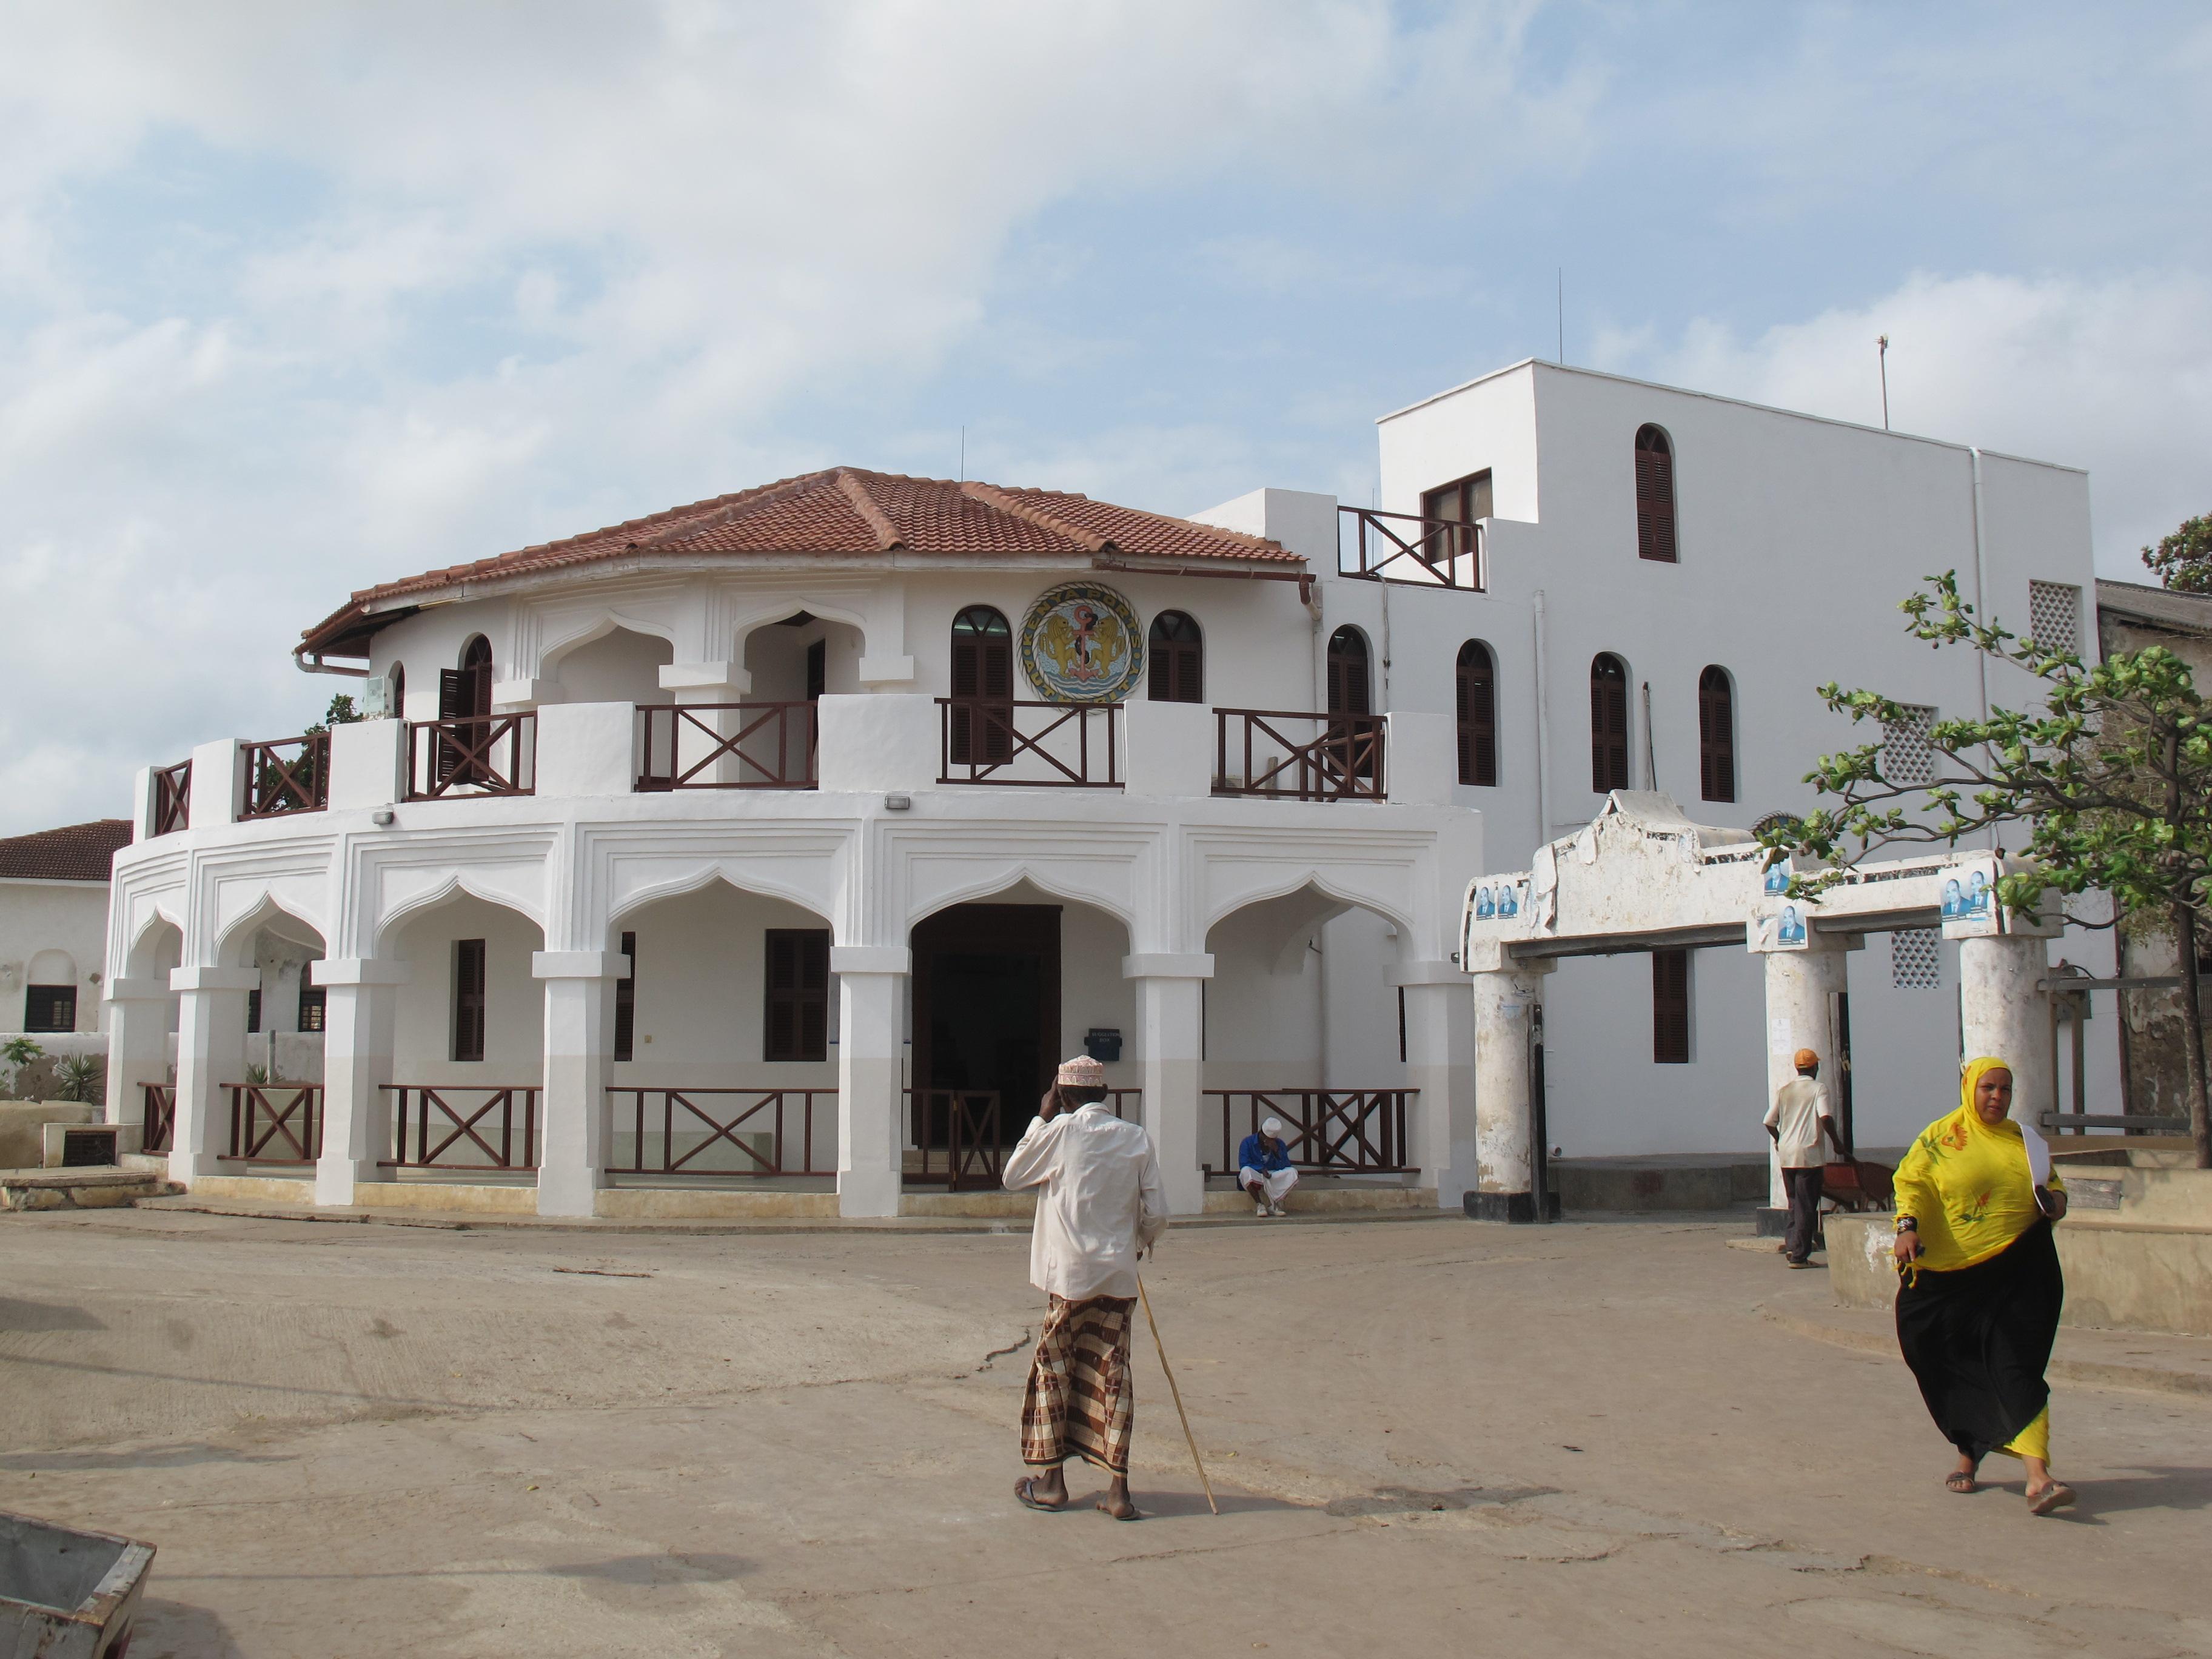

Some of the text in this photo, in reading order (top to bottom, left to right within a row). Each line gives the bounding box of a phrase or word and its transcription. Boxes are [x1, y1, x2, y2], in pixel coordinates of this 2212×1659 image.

[1022, 590, 1141, 648] KENYA PORTS
[1025, 660, 1139, 703] AUTHRITY
